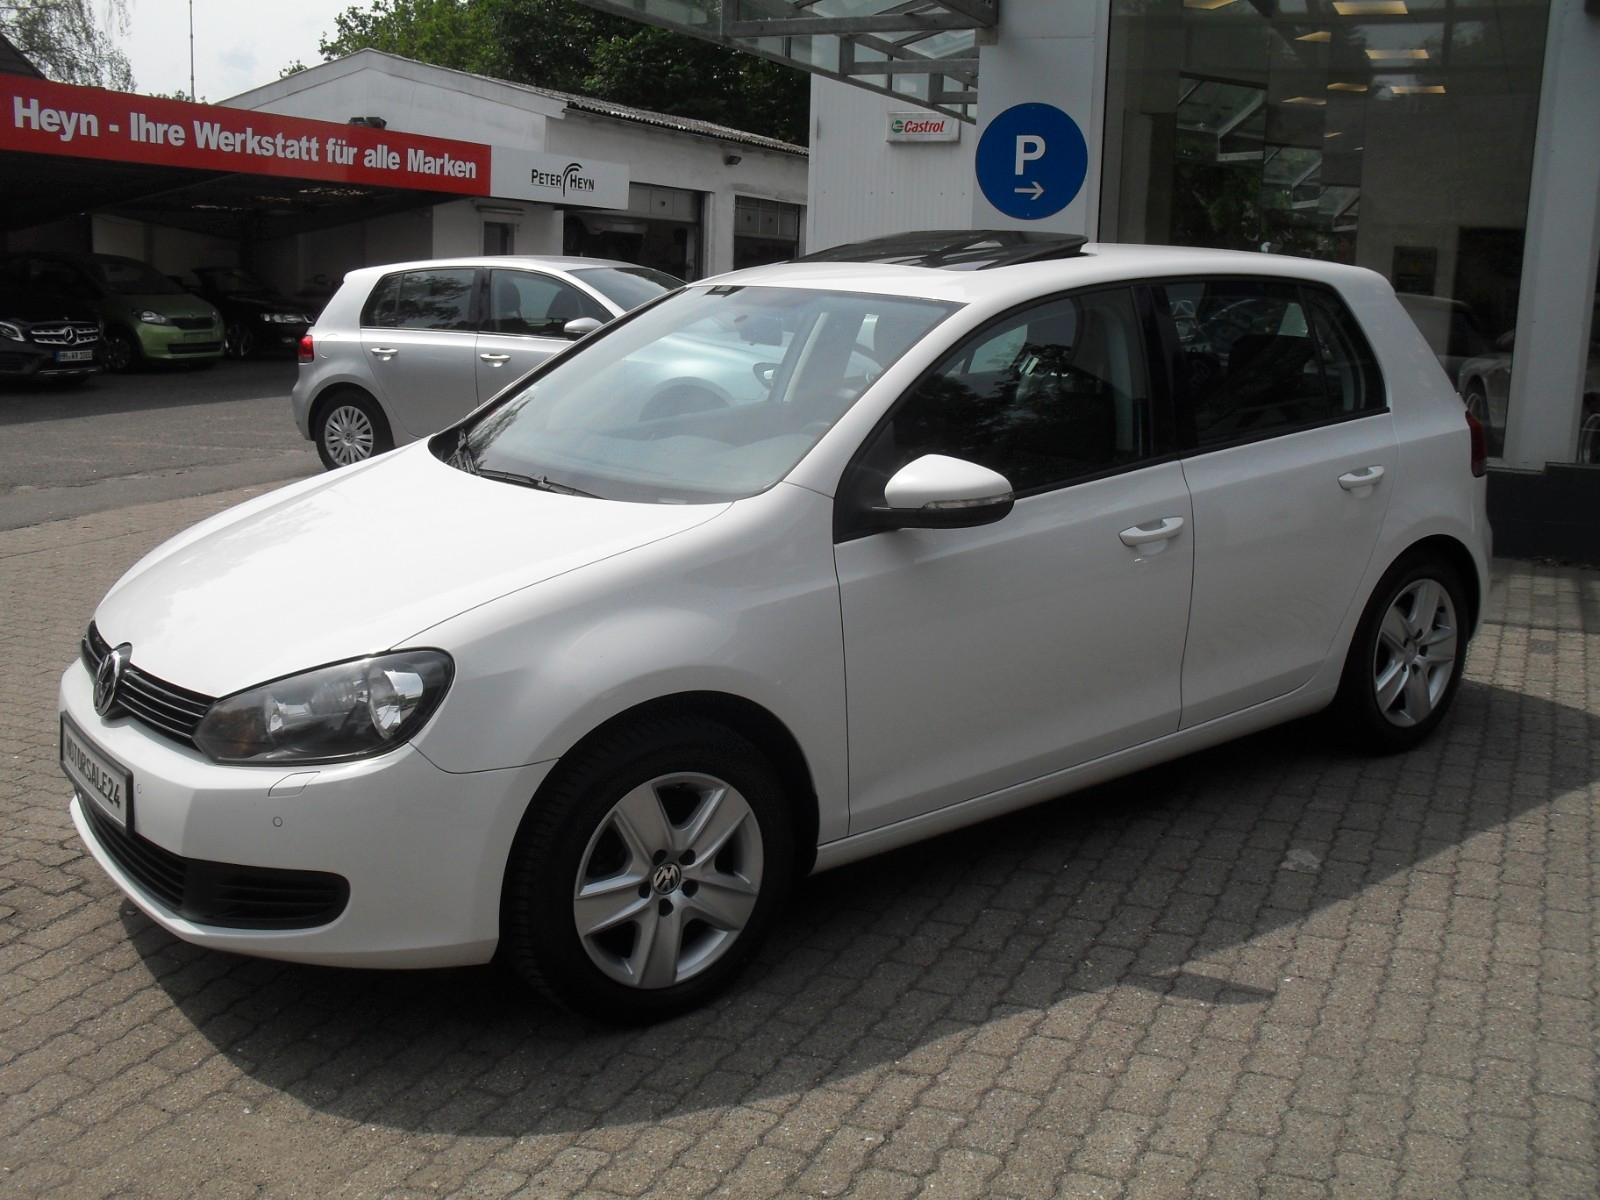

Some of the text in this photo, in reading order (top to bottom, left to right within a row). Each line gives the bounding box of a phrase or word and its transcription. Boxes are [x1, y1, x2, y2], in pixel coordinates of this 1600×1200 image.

[13, 96, 476, 179] Heyn - Ihre Werkstatt für alle Marken
[904, 120, 944, 133] Castrol
[1015, 135, 1046, 175] P
[531, 168, 594, 191] PETER HEYN
[66, 733, 120, 808] MOTORSALE24
